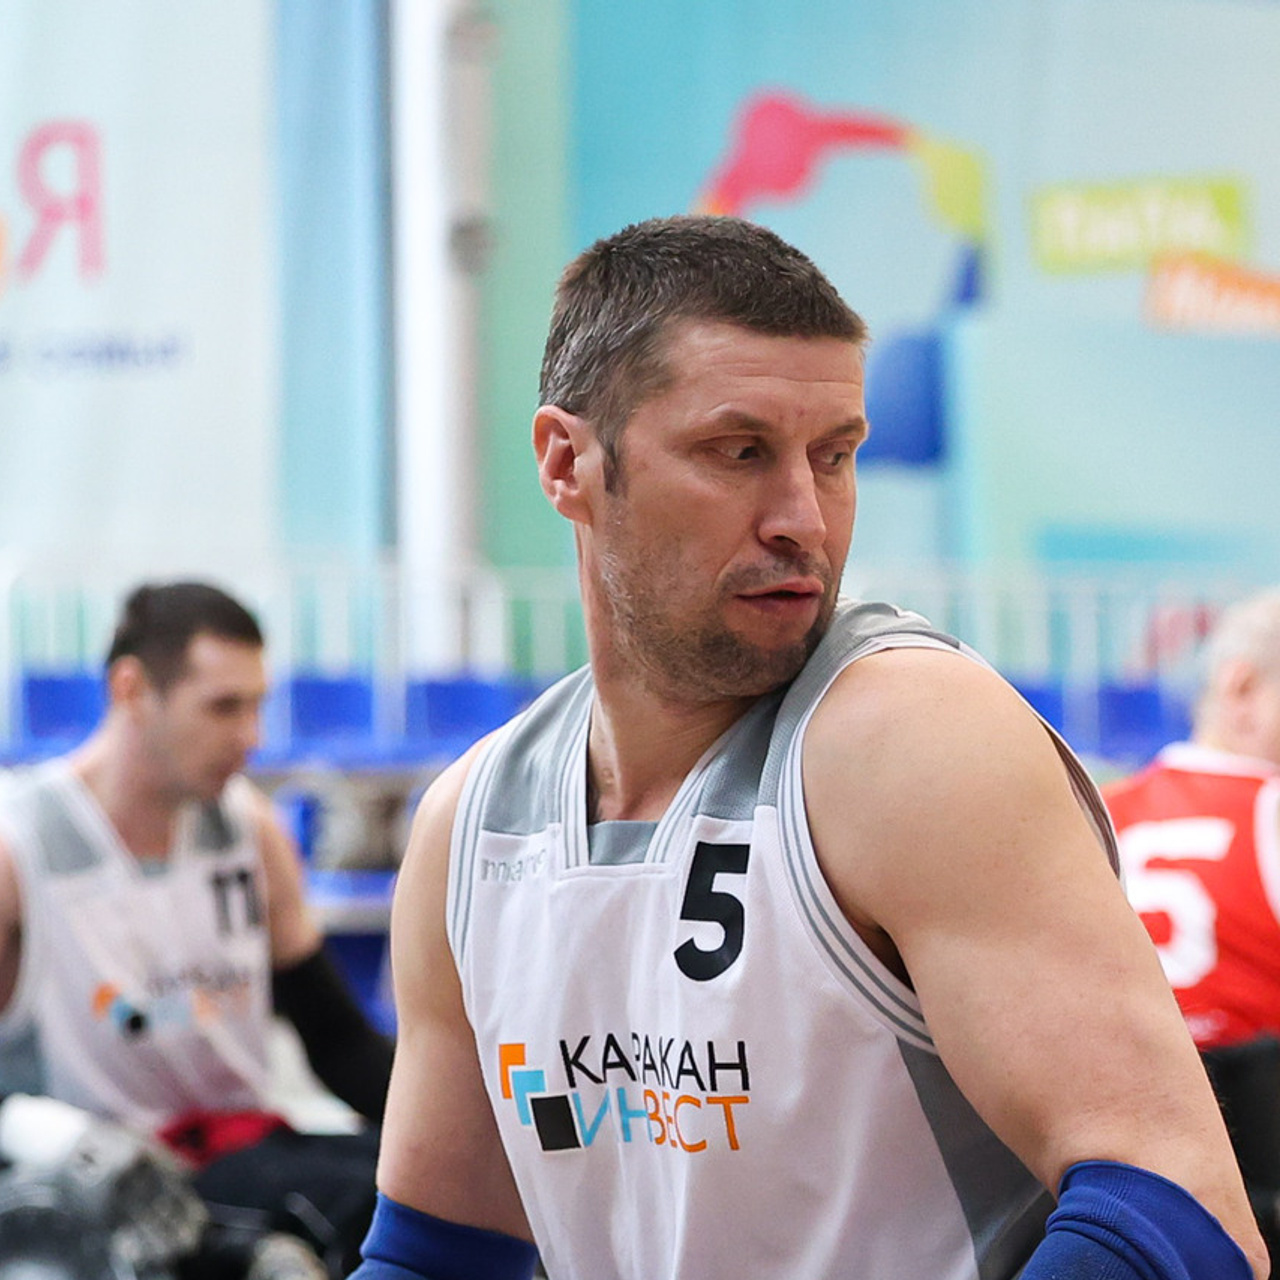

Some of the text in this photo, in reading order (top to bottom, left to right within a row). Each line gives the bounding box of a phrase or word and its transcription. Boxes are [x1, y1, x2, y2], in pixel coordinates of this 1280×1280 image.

[15, 117, 107, 290] Я
[674, 840, 751, 982] 5
[559, 1031, 751, 1092] КАРАКАН
[571, 1086, 750, 1153] ИНВЕСТ
